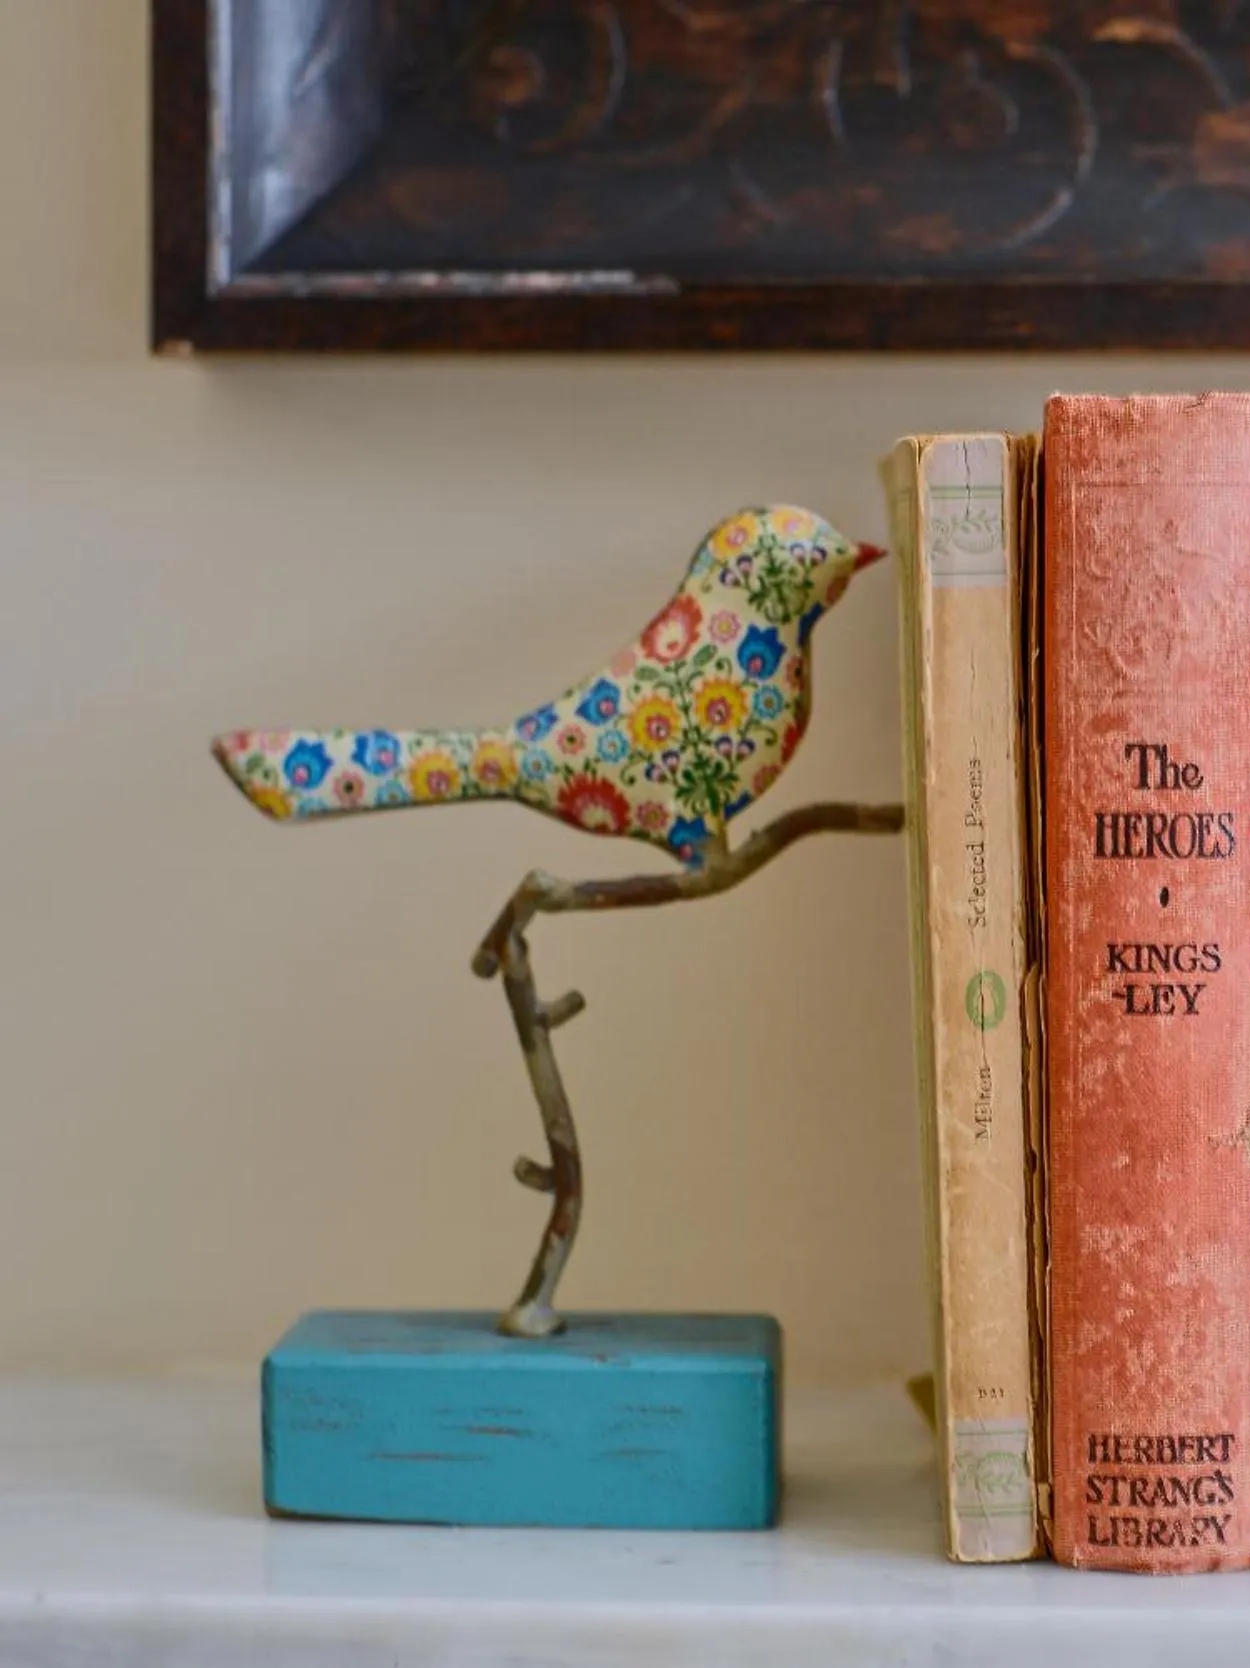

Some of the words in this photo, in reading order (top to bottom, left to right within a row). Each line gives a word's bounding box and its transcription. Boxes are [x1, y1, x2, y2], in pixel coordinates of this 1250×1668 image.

[1124, 743, 1204, 791] The
[1093, 812, 1236, 860] HEROES
[967, 841, 987, 928] Selected
[1105, 943, 1222, 974] KINGS
[1111, 984, 1207, 1016] -LEY
[1087, 1433, 1236, 1465] HERBERT
[1086, 1513, 1233, 1548] LIBRARY
